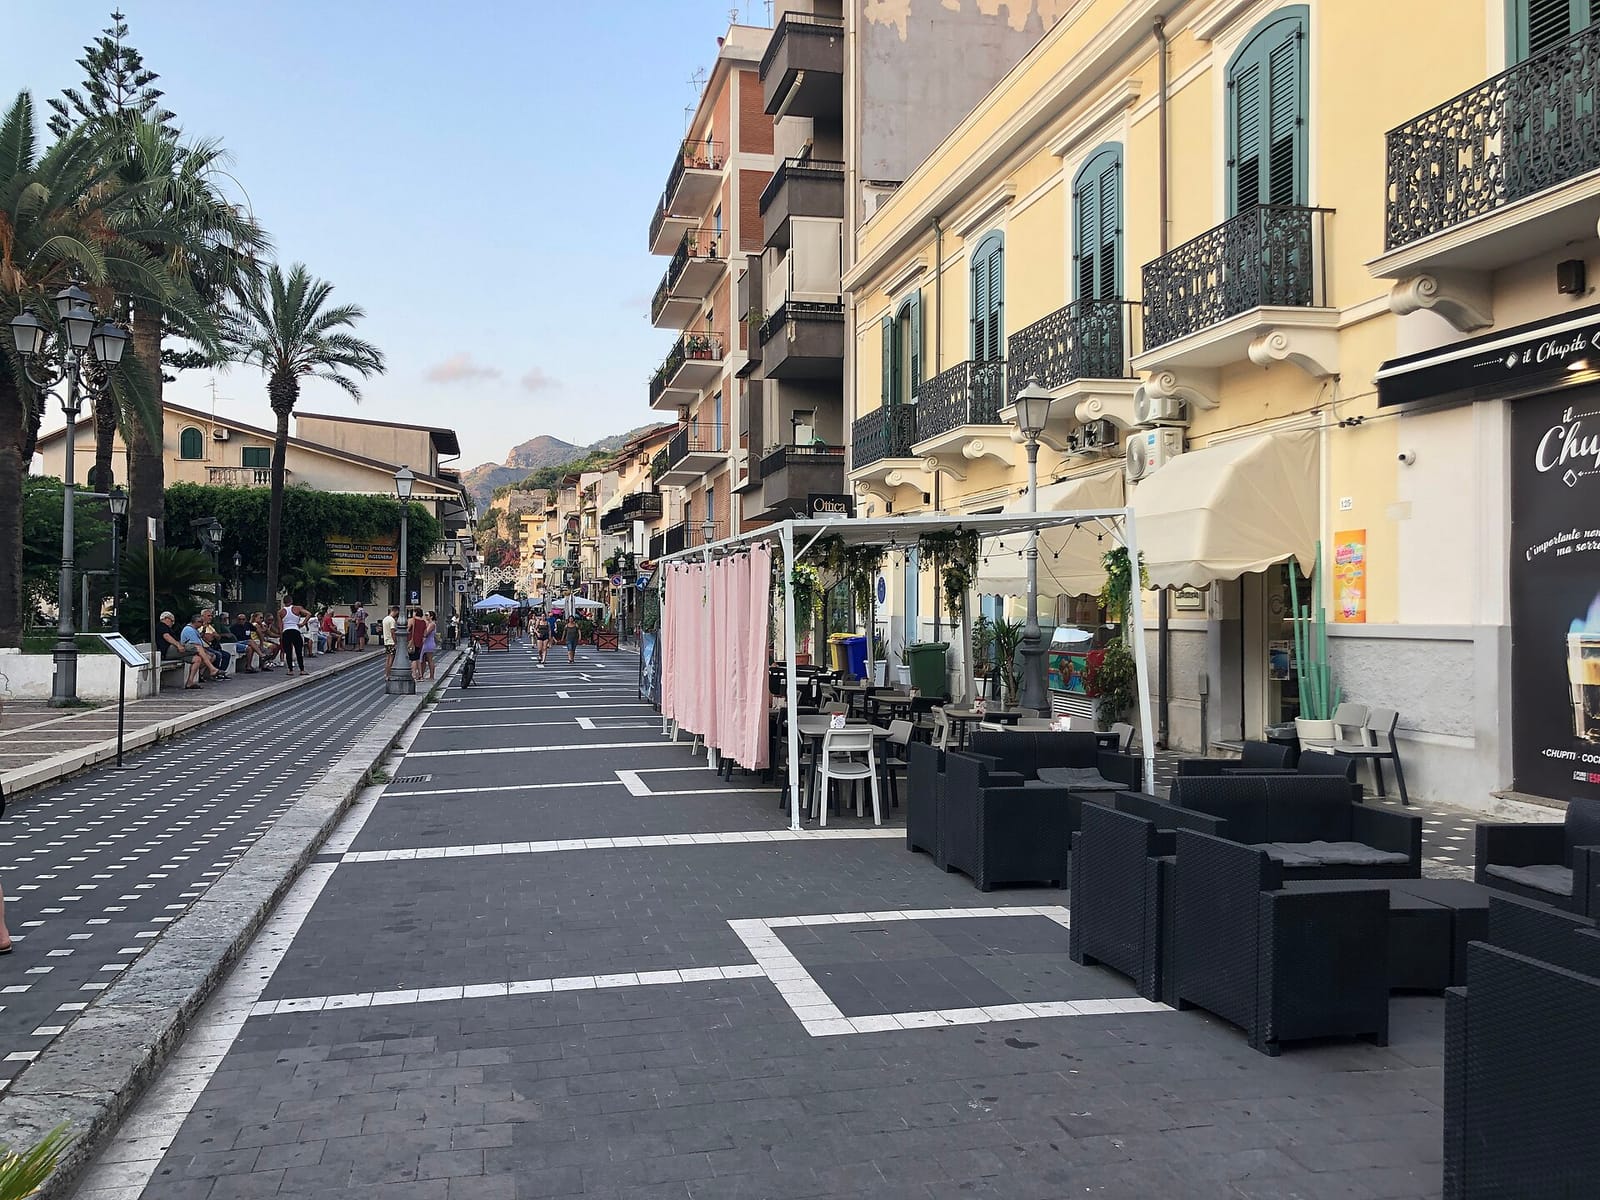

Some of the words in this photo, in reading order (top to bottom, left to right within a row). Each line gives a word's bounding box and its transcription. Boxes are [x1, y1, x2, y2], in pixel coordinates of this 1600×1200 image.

[1522, 349, 1531, 363] il
[1536, 333, 1587, 363] Chupito
[1562, 406, 1573, 423] il
[813, 497, 846, 512] Ottica
[1556, 545, 1572, 557] ma
[1546, 749, 1576, 760] CHUPITI
